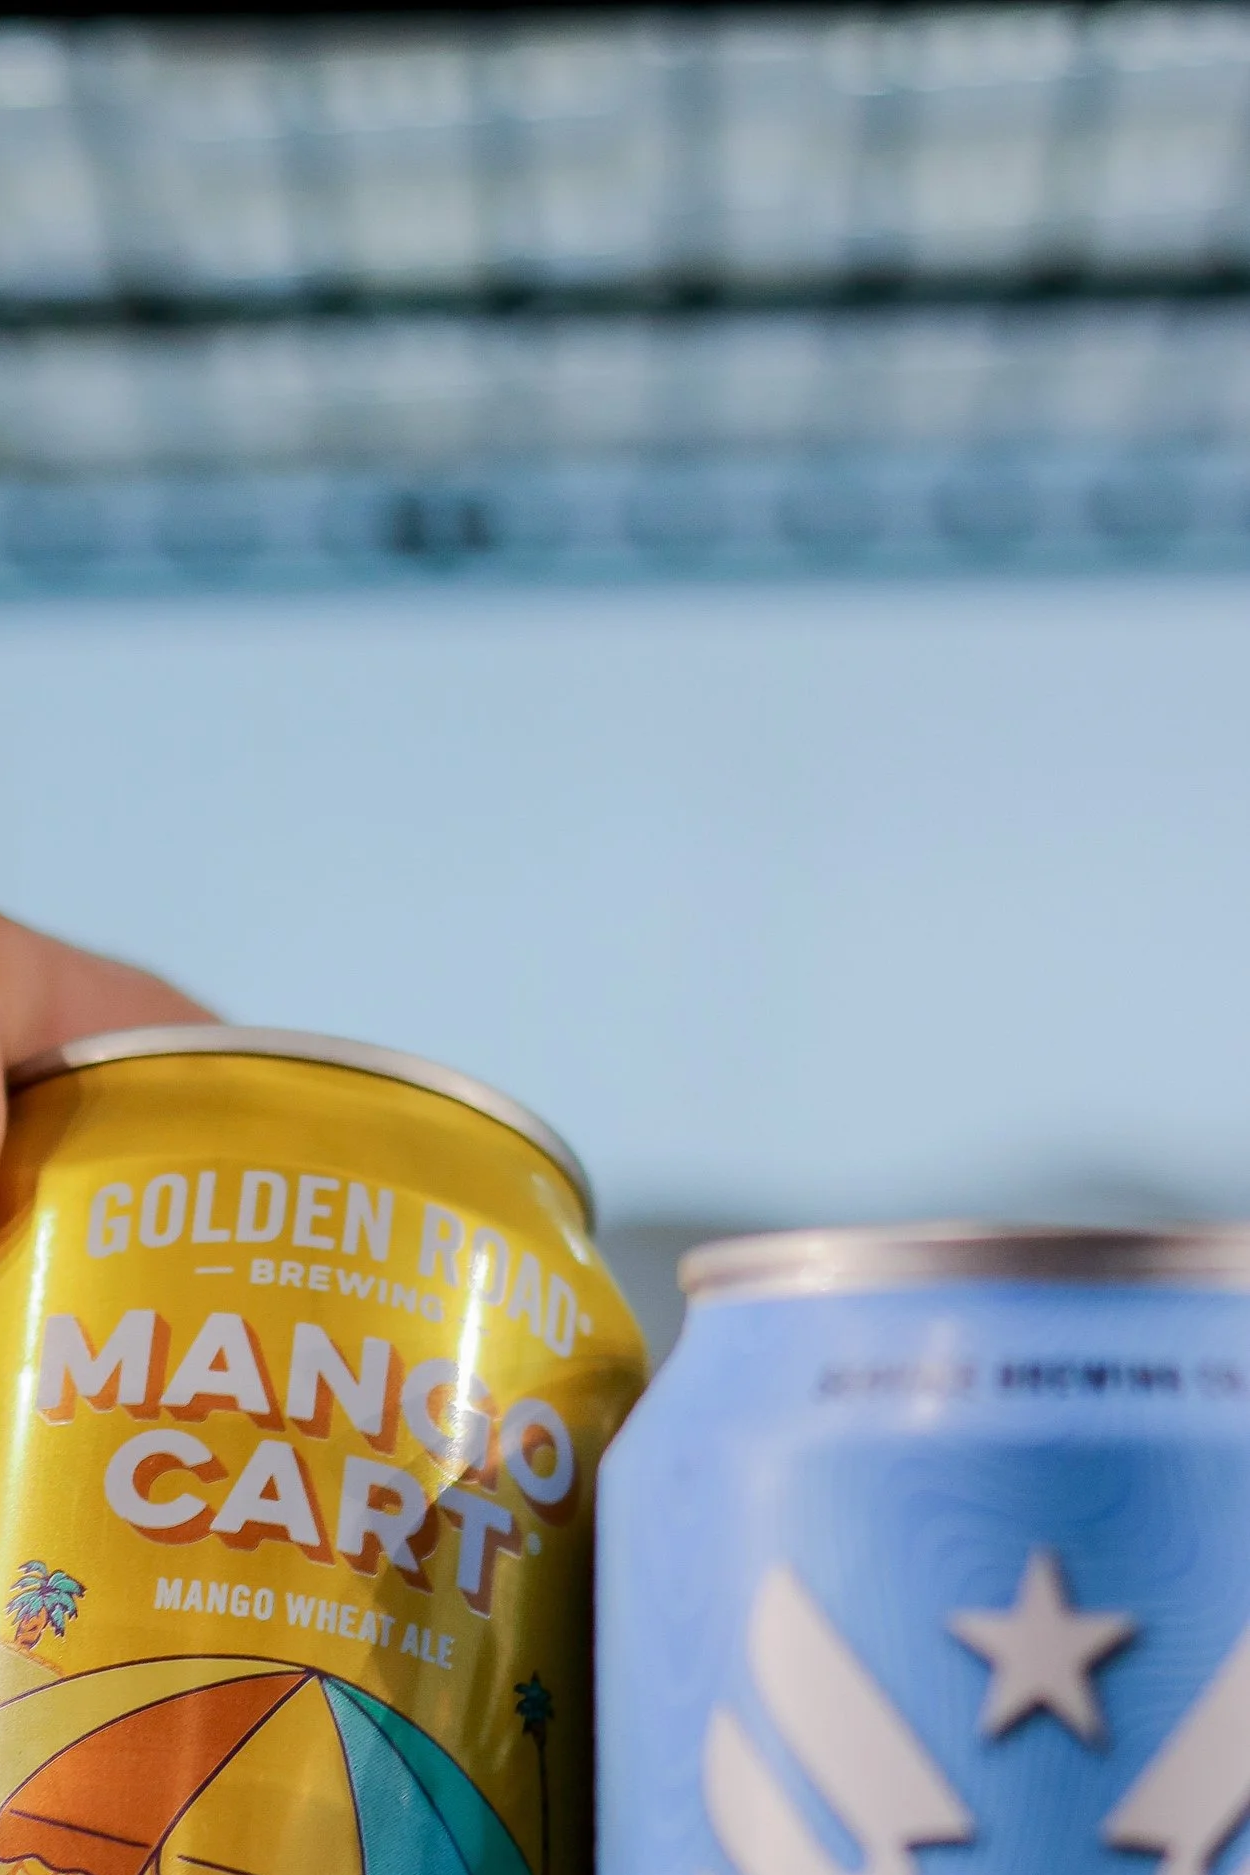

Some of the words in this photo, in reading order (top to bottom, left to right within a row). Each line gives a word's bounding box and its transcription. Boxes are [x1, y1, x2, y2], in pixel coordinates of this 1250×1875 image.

[85, 1169, 395, 1264] GOLDEN
[250, 1257, 446, 1323] BREWING
[34, 1308, 582, 1522] MANGO
[104, 1427, 520, 1614] CART
[154, 1576, 275, 1622] MANGO
[287, 1591, 396, 1650] WHEAT
[400, 1626, 455, 1671] ALE
